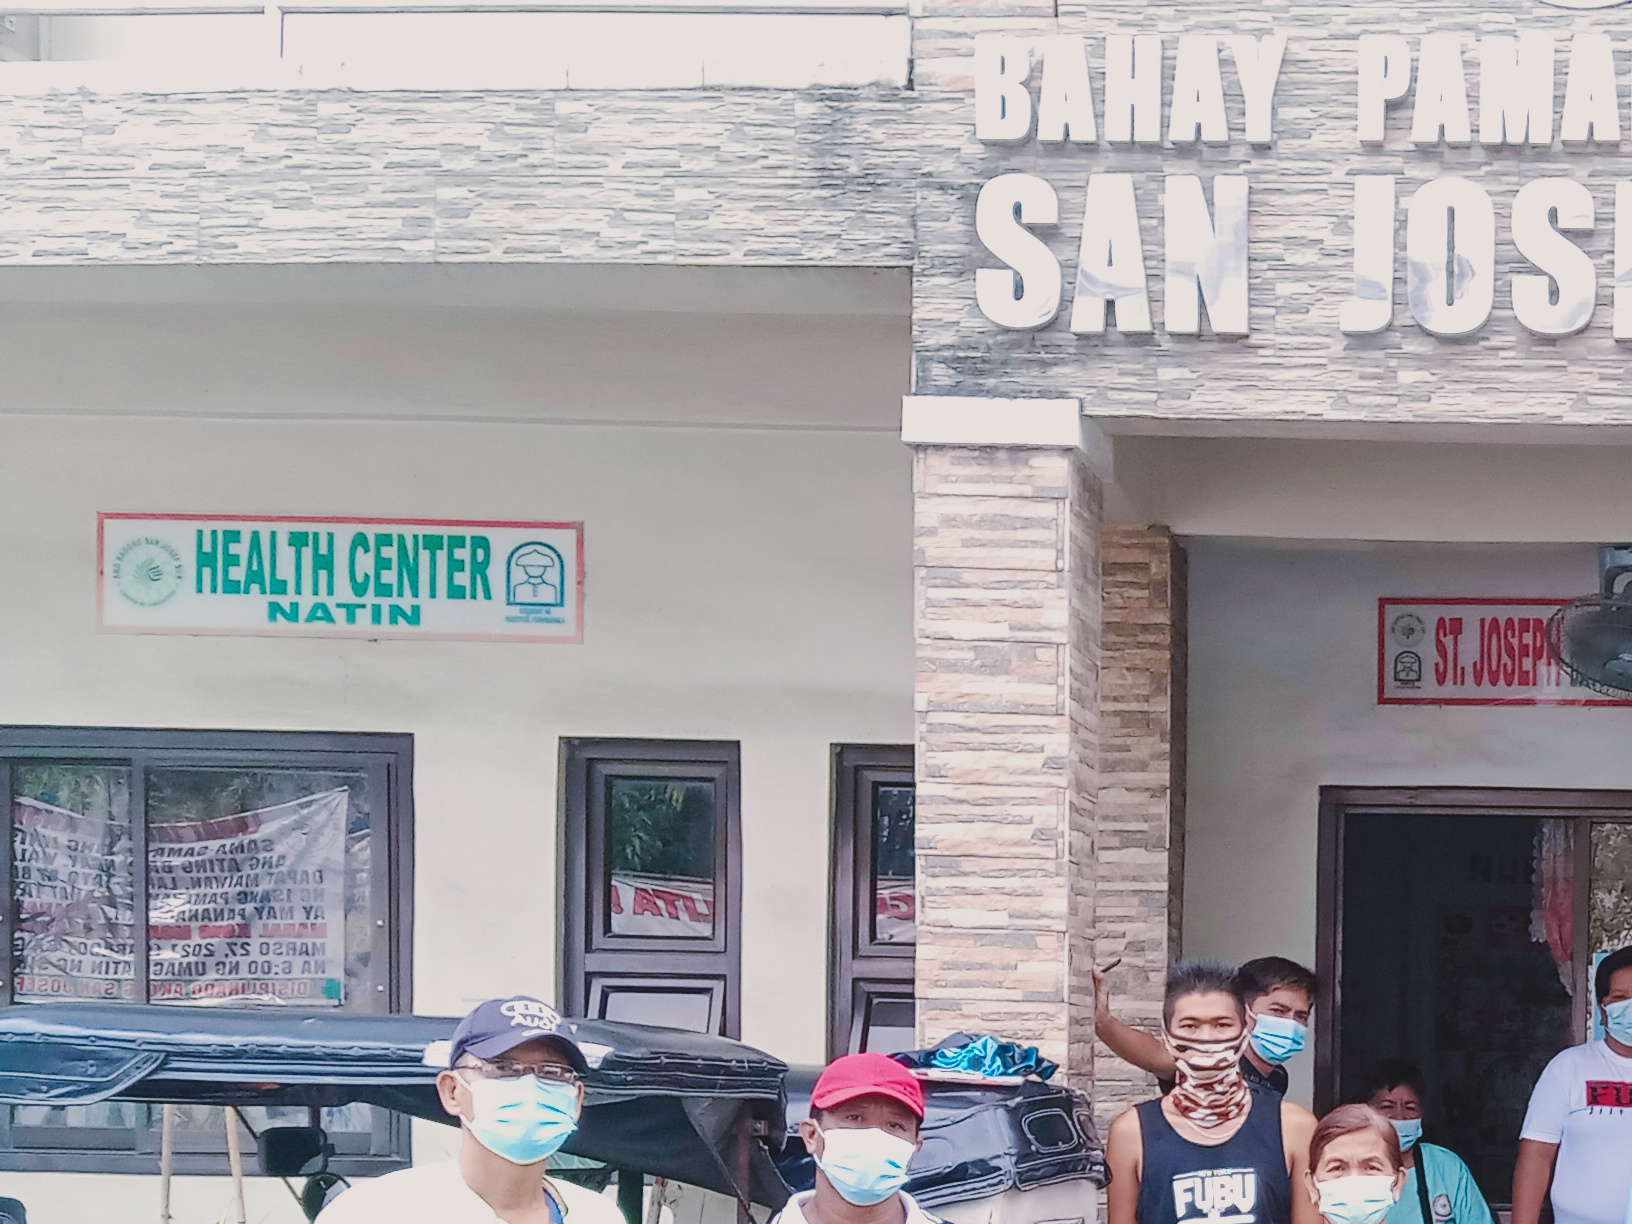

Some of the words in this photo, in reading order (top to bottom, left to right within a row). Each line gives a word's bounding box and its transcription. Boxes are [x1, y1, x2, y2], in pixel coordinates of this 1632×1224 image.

[973, 32, 1286, 144] BAHAY
[973, 172, 1250, 335] SAN
[196, 529, 334, 596] HEALTH
[349, 531, 492, 600] CENTER
[267, 601, 421, 626] NATIN
[1434, 616, 1466, 687] ST.
[1173, 1173, 1255, 1220] FUBU
